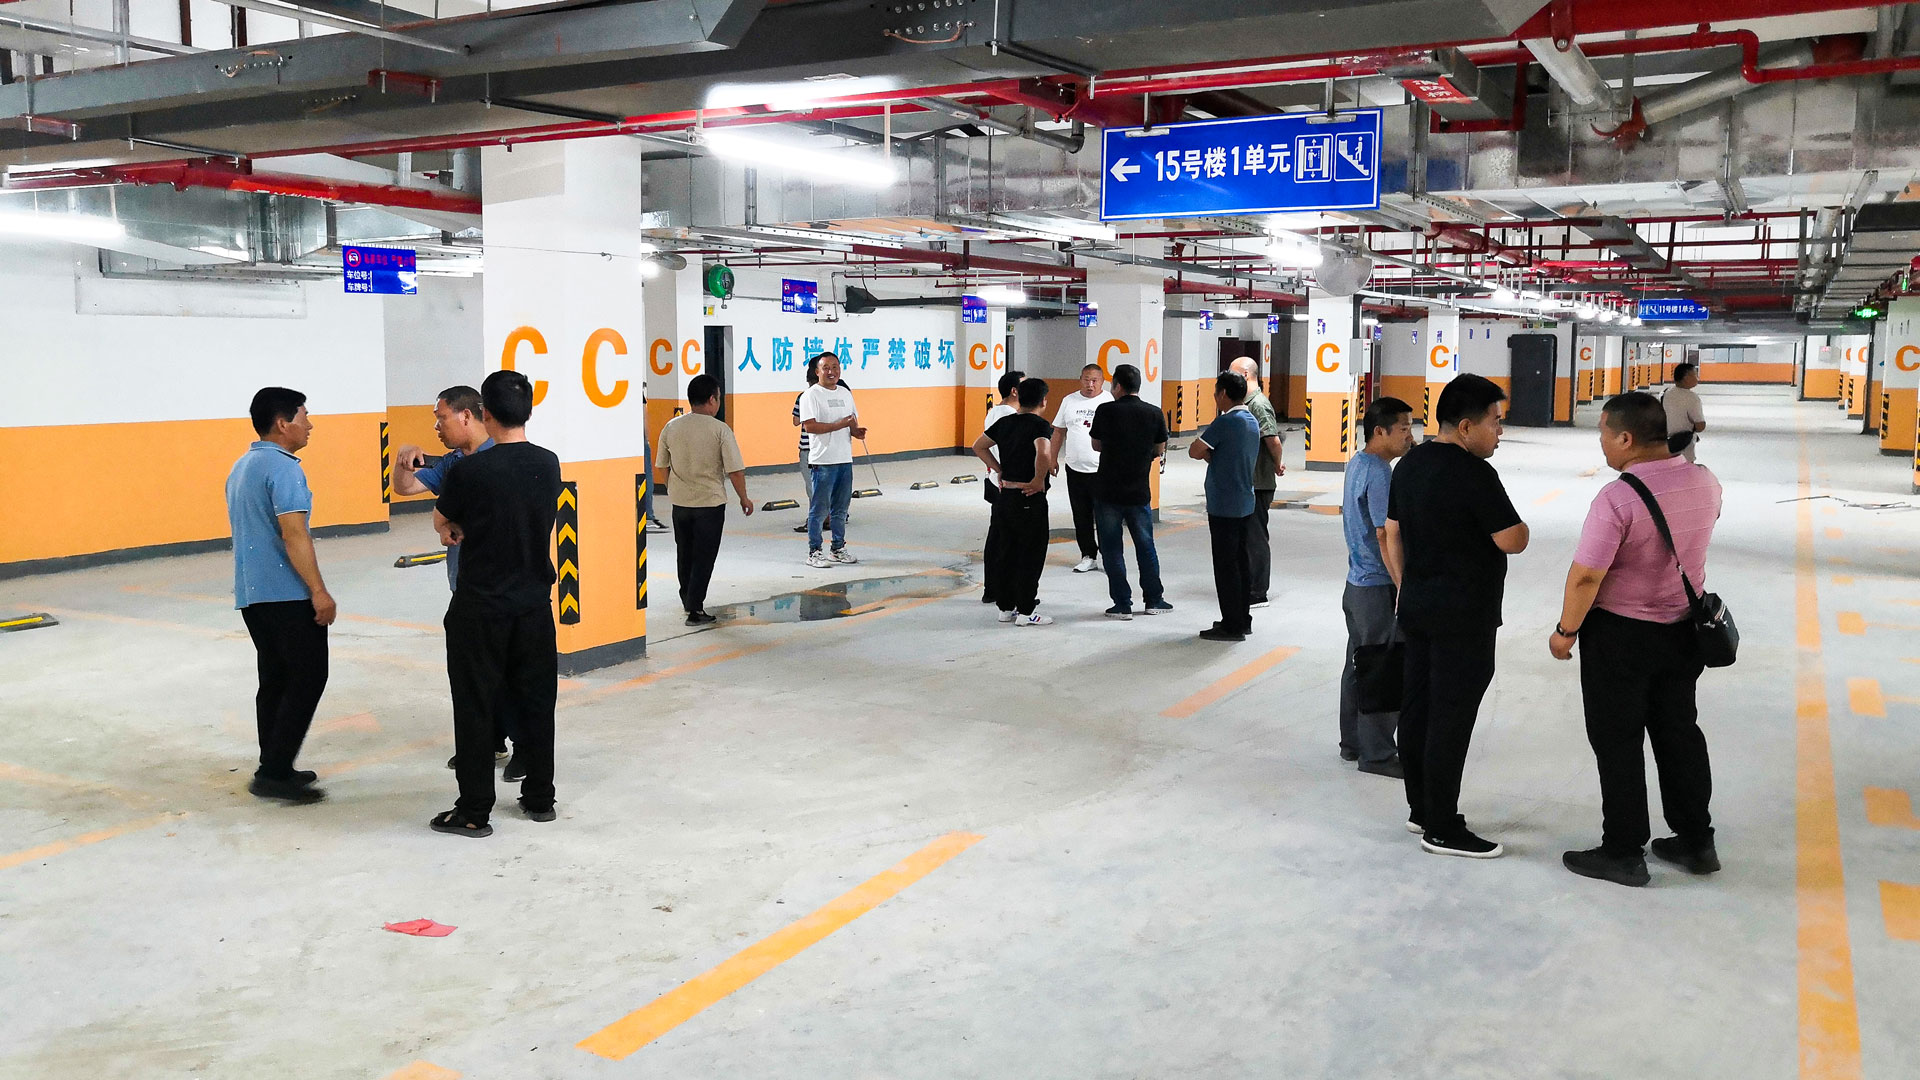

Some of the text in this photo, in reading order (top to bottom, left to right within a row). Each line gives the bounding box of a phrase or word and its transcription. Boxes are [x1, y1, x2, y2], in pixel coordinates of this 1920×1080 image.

[1155, 143, 1291, 182] 15号楼1单元
[502, 326, 549, 407] C
[582, 327, 629, 408] C
[650, 338, 673, 376] C
[681, 338, 701, 375] C
[738, 336, 955, 371] 人防墙体严禁破坏
[969, 343, 987, 370] C
[993, 343, 1004, 370] C
[1097, 339, 1130, 382] C
[1145, 338, 1158, 383] C
[1316, 342, 1340, 373] C
[1430, 345, 1449, 368] C
[1580, 347, 1592, 361] C
[1665, 349, 1673, 358] C
[1895, 345, 1920, 372] C
